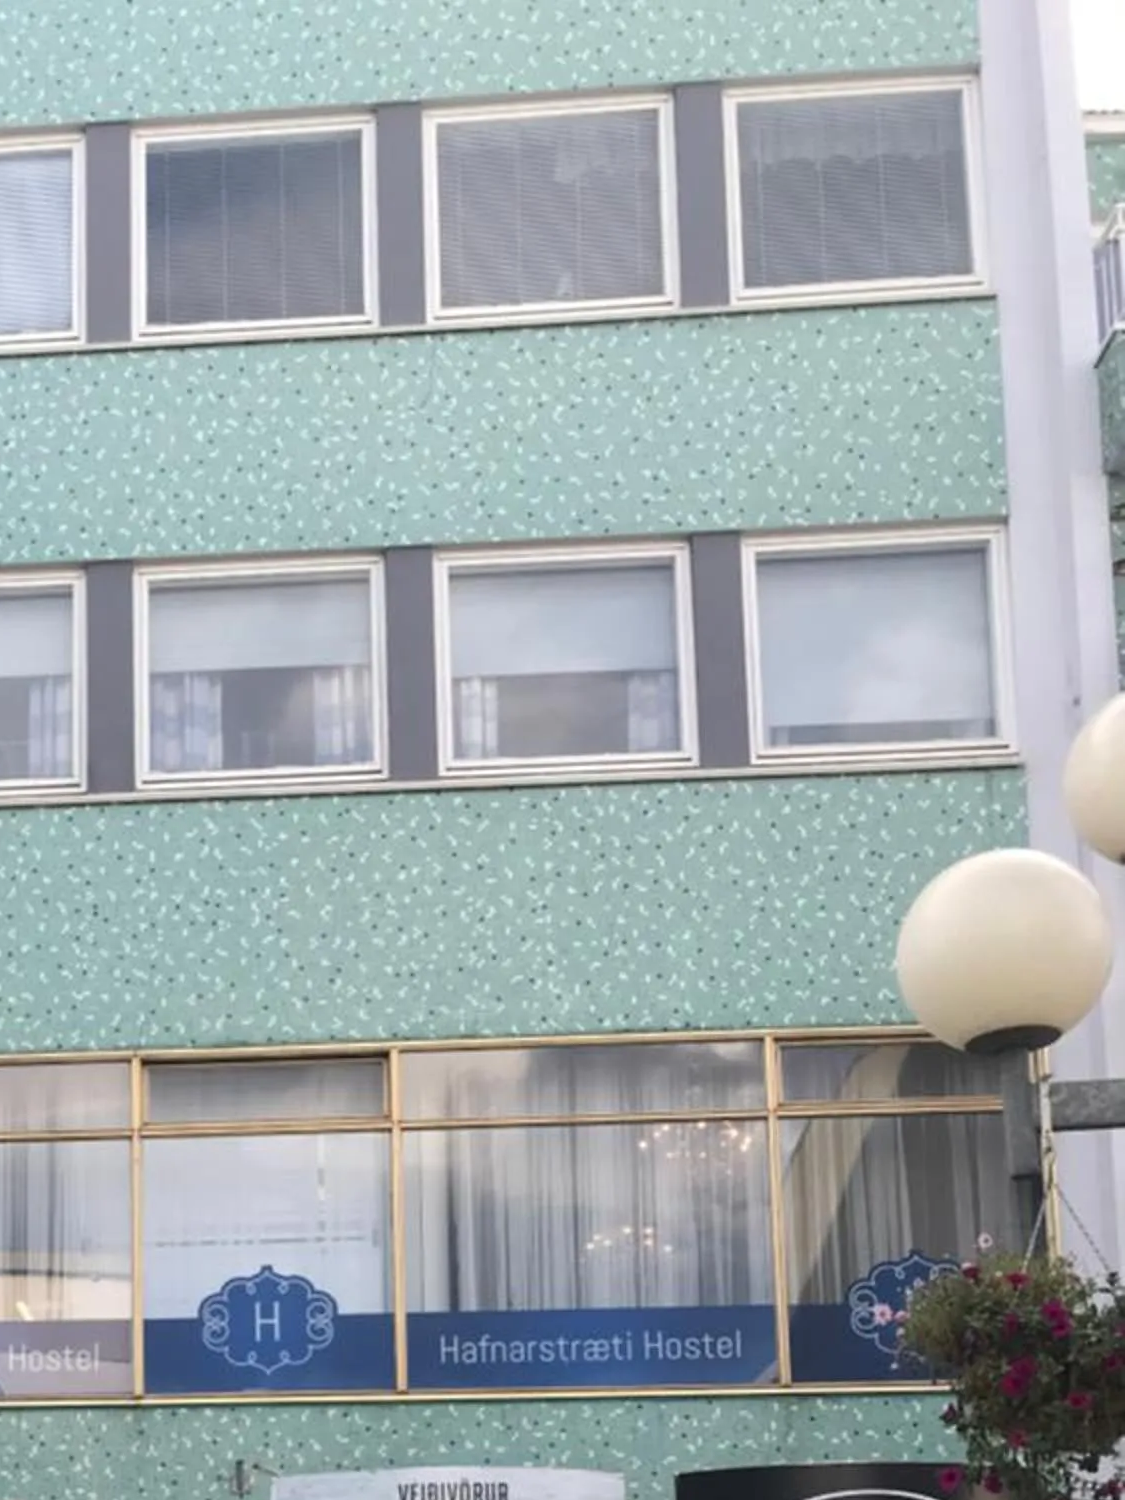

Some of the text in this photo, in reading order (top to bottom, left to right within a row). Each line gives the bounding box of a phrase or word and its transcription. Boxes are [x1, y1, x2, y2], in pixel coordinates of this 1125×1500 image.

[254, 1300, 280, 1343] H
[7, 1342, 101, 1373] Hostel
[439, 1328, 742, 1364] Hafnarstræti Hostel
